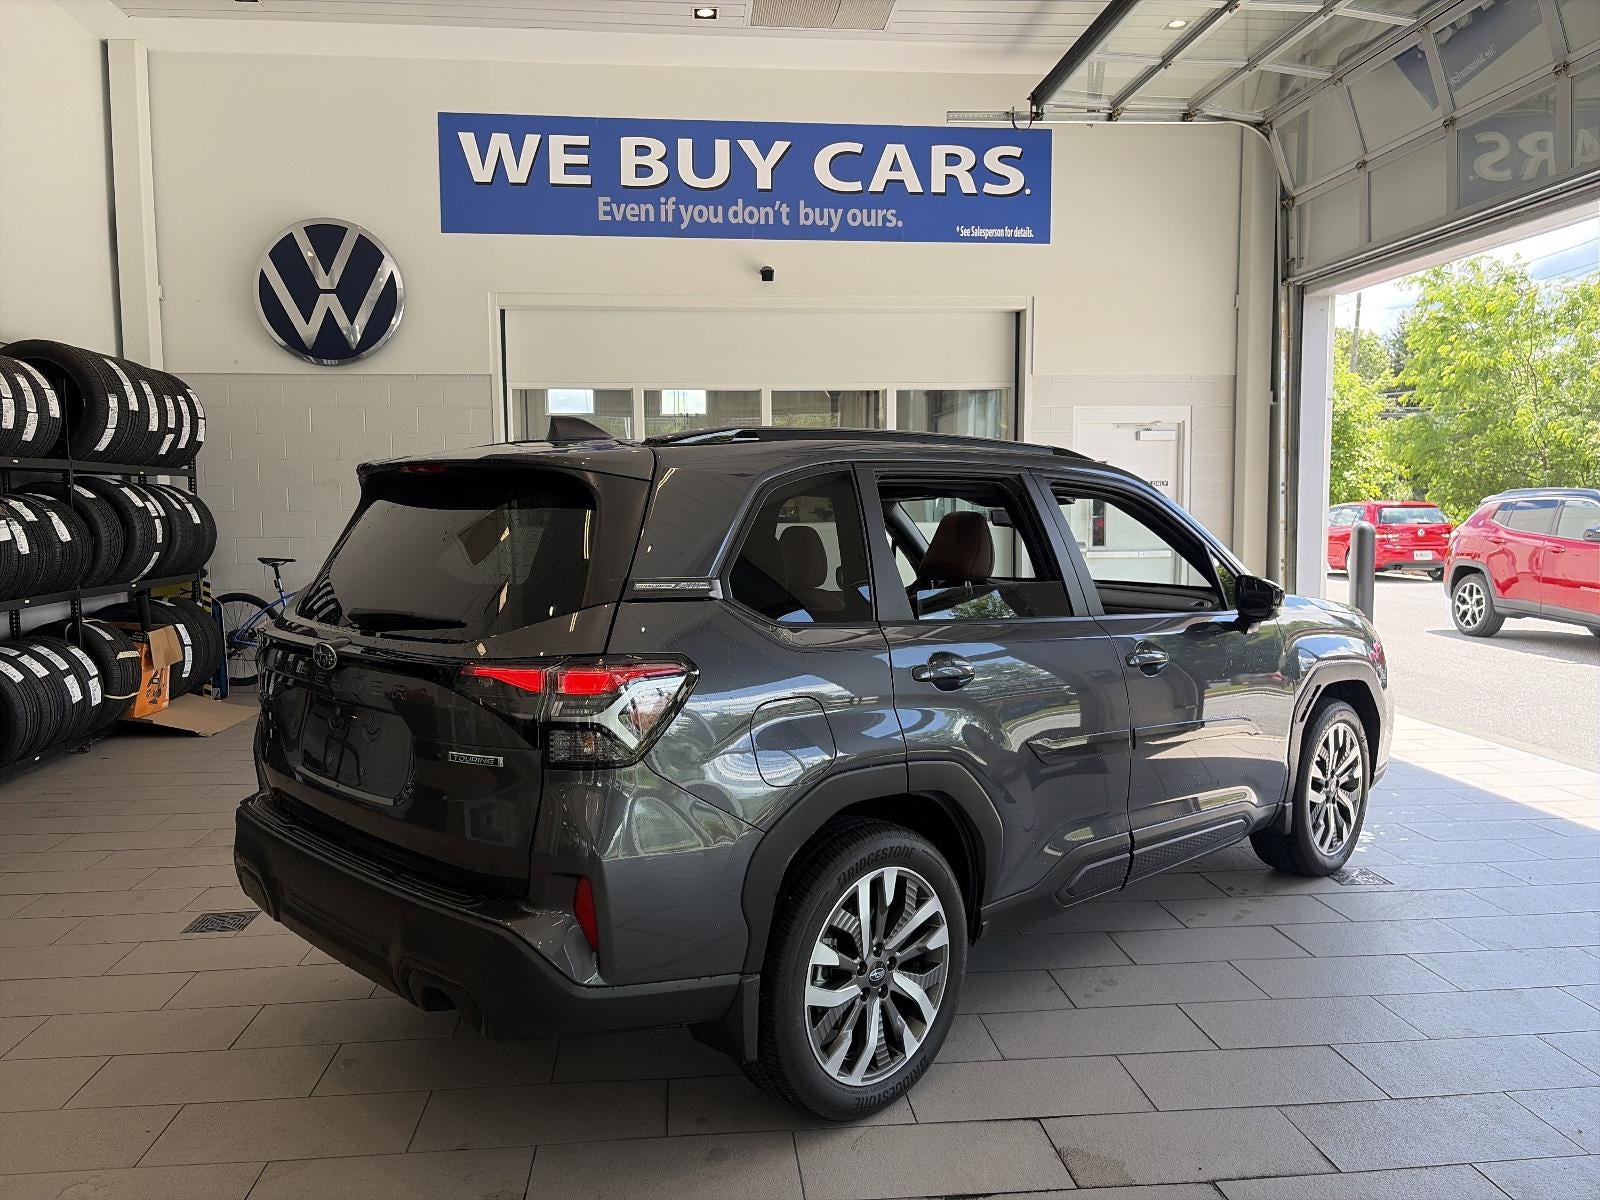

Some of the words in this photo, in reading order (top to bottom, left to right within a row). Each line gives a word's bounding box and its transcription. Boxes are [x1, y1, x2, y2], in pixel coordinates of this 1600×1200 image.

[457, 132, 593, 187] WE
[620, 137, 791, 192] BUY
[813, 142, 1031, 197] CARS.
[597, 196, 655, 222] Even
[660, 197, 676, 223] if
[680, 203, 723, 230] you
[728, 199, 790, 226] don't
[799, 198, 843, 232] buy
[846, 207, 903, 228] ours.
[971, 225, 1004, 240] Salesperson
[1004, 226, 1014, 238] for
[1014, 227, 1034, 238] details.
[453, 754, 495, 766] TOURING
[837, 845, 916, 888] BRIDGESTONE
